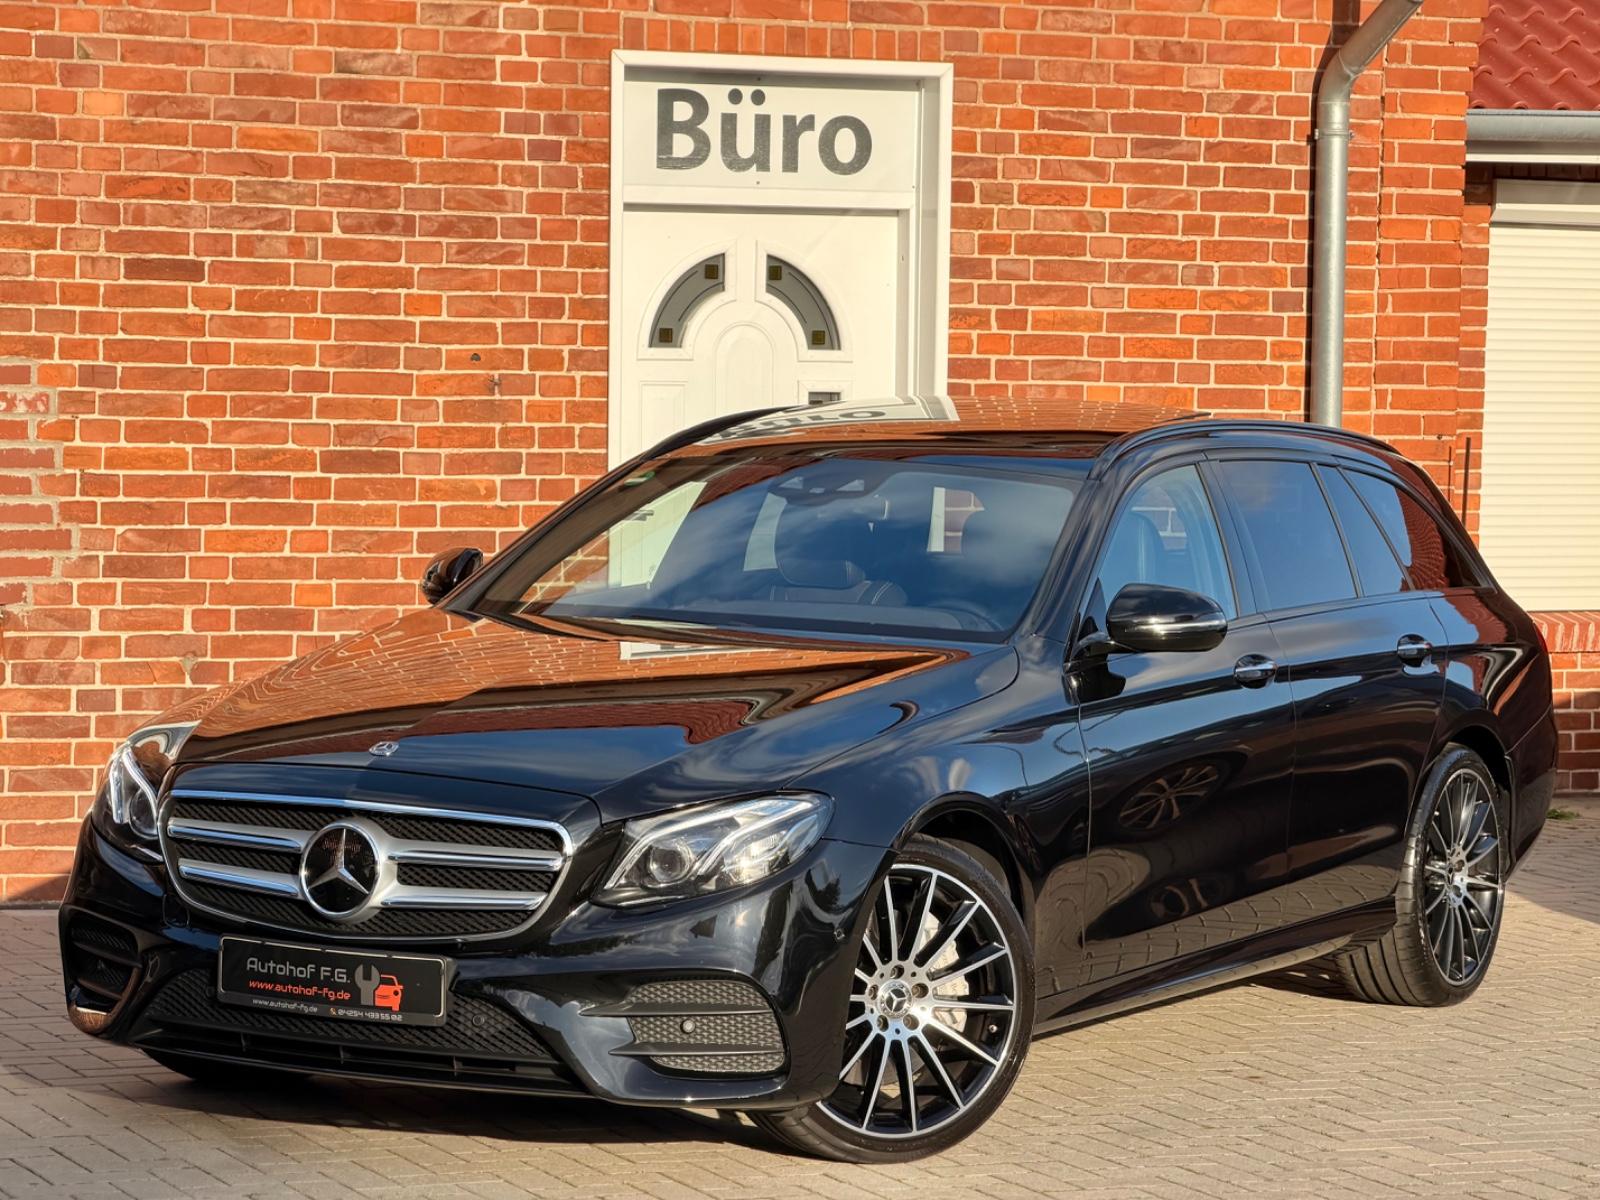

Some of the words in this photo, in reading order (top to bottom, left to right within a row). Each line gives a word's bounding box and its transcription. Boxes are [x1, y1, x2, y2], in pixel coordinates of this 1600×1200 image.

[656, 87, 873, 176] Büro
[246, 957, 316, 979] Autohof
[320, 966, 351, 984] F.G.
[248, 980, 351, 1001] www.autohof-fg.de
